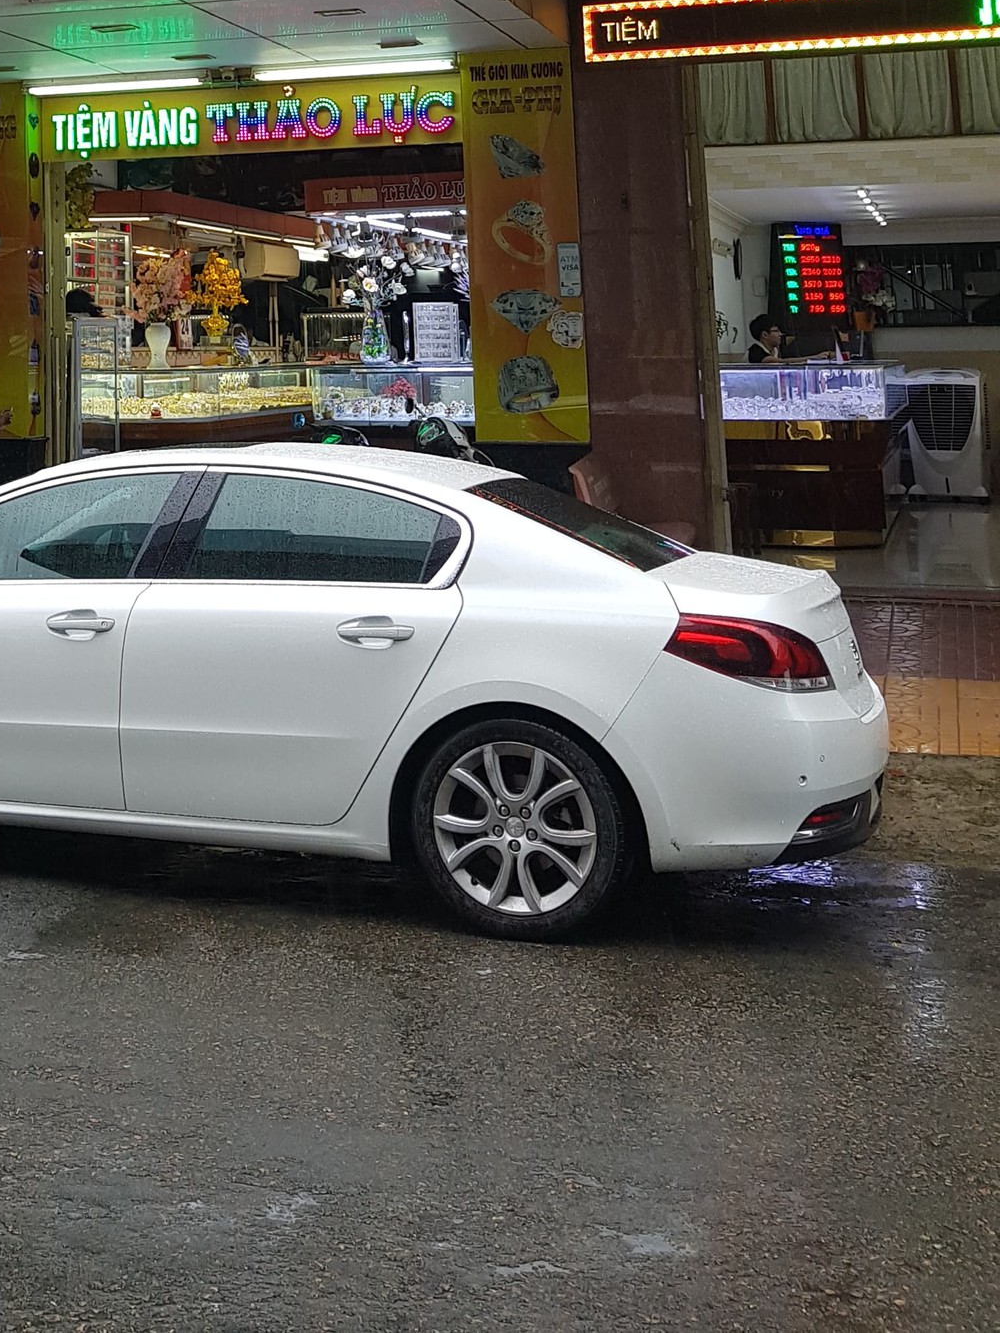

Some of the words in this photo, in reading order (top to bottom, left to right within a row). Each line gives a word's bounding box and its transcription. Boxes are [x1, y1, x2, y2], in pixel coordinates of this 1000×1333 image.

[601, 16, 659, 45] TIỆM
[51, 103, 118, 160] TIỆM
[124, 99, 198, 148] VÀNG
[204, 84, 343, 144] THẢO
[352, 84, 456, 144] LỰC
[381, 177, 437, 202] THẢO
